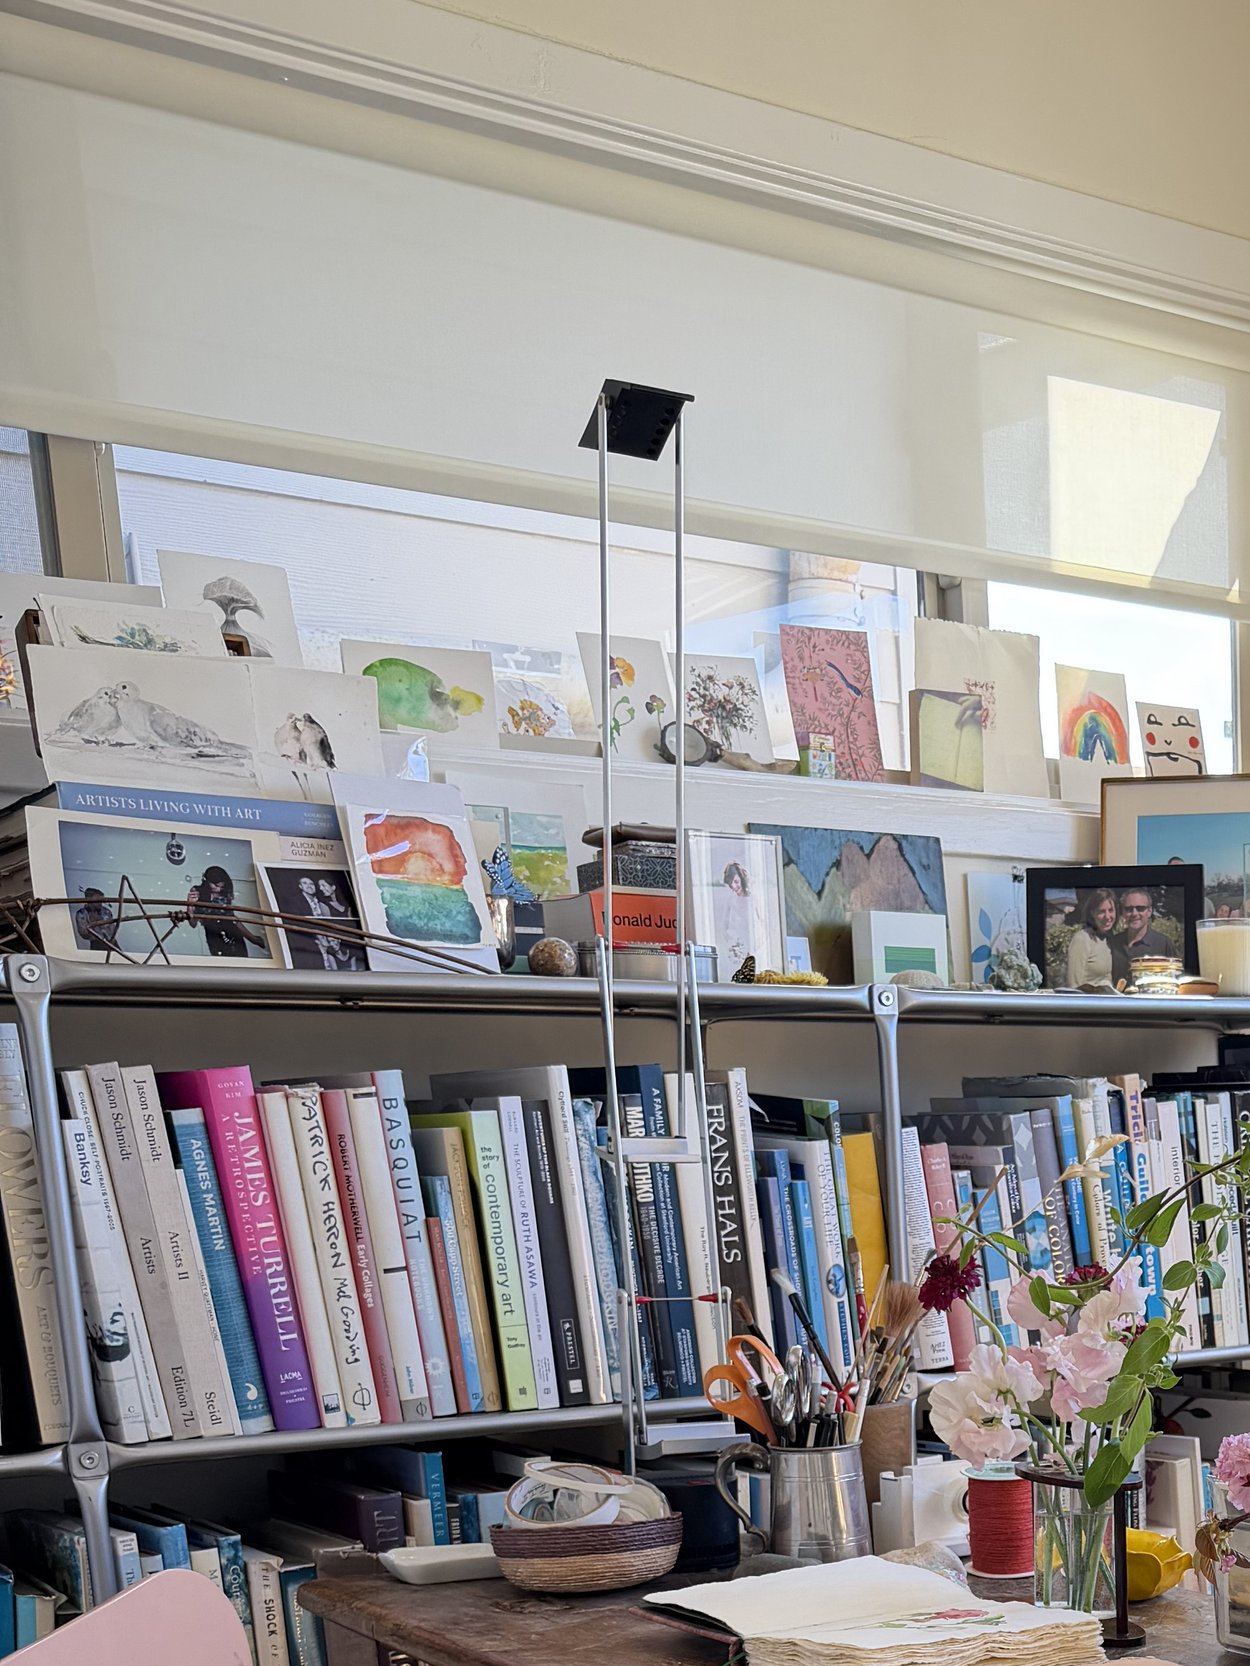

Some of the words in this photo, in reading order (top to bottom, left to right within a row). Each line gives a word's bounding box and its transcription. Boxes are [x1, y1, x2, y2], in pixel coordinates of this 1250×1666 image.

[76, 794, 136, 809] ARTISTS
[140, 799, 190, 813] LIVING
[193, 804, 231, 818] WITH
[235, 808, 262, 820] ART
[290, 841, 315, 850] ALICIA
[317, 842, 334, 850] INEZ
[602, 911, 651, 928] onald
[226, 1091, 242, 1099] KIM
[557, 1091, 568, 1117] Clyfford
[651, 1087, 659, 1095] A
[734, 1080, 744, 1107] AXSOM
[651, 1097, 664, 1135] FAMILY
[338, 1134, 350, 1171] ROBERT
[511, 1143, 520, 1157] THE
[706, 1104, 733, 1187] FRANS
[738, 1129, 748, 1152] PRINTS
[74, 1132, 92, 1186] Banksy
[382, 1097, 422, 1243] BASQUIAT
[742, 1154, 749, 1162] OF
[817, 1163, 826, 1178] OF
[821, 1150, 832, 1173] THE
[1167, 1145, 1185, 1185] interior
[512, 1158, 525, 1193] SCULPTURE
[655, 1171, 667, 1200] Collection
[661, 1173, 672, 1197] Modern
[743, 1164, 755, 1201] ELLSWORTH
[191, 1139, 211, 1190] AGNES
[203, 1194, 226, 1251] MARTIN
[222, 1114, 230, 1122] A
[226, 1132, 262, 1275] RETROSPECTIVE
[344, 1175, 365, 1242] MOTHERWELL
[519, 1197, 526, 1209] OF
[782, 1186, 790, 1201] THE
[818, 1183, 831, 1216] YOUR
[824, 1178, 839, 1217] GREAT
[1043, 1196, 1056, 1218] OF
[1070, 1184, 1078, 1203] Century
[1091, 1184, 1103, 1216] Colors
[1098, 1223, 1103, 1231] of
[519, 1211, 532, 1242] RUTH
[647, 1205, 656, 1218] THE
[660, 1209, 671, 1234] Stanford
[749, 1202, 757, 1220] KELLY
[1101, 1189, 1119, 1242] White
[234, 1111, 270, 1207] JAMES
[256, 1214, 299, 1351] TURRELL
[301, 1093, 331, 1191] PATRICK
[322, 1201, 346, 1269] HERON
[341, 1306, 361, 1365] Gooding
[648, 1220, 662, 1253] DECISIVE
[664, 1210, 680, 1251] Contemporary
[700, 1239, 708, 1250] Roy
[716, 1195, 742, 1264] HALS
[785, 1204, 797, 1257] CROSSROADS
[823, 1221, 835, 1247] LIFE
[828, 1223, 843, 1258] WORK
[102, 1077, 118, 1109] Jason
[112, 1111, 132, 1161] Schmidt
[140, 1237, 156, 1275] Artists
[171, 1366, 188, 1408] Edition
[182, 1411, 195, 1427] 7L
[134, 1079, 149, 1110] Jason
[143, 1113, 162, 1162] Schmidt
[168, 1231, 183, 1268] Artists
[178, 1272, 189, 1281] II
[204, 1391, 222, 1426] Steidl
[357, 1244, 368, 1271] Early
[485, 1174, 509, 1288] contemporary
[501, 1291, 515, 1316] art
[663, 1235, 676, 1263] University
[1048, 1224, 1066, 1283] COLOR
[523, 1245, 538, 1288] ASAWA
[652, 1255, 665, 1283] DECADE
[671, 1251, 683, 1279] American
[791, 1259, 798, 1269] OF
[361, 1270, 375, 1308] Collages
[409, 1258, 425, 1310] NOTEBOOKS
[453, 1264, 463, 1296] Street
[676, 1279, 684, 1290] Art
[36, 1305, 49, 1329] ART
[565, 1332, 575, 1364] PRESTEL
[837, 1302, 847, 1339] STEPHEN
[842, 1343, 850, 1364] COPE
[931, 1356, 949, 1364] TERRA
[280, 1371, 303, 1384] LACMA
[431, 1474, 444, 1537] VERMEER
[260, 1566, 271, 1589] THE
[263, 1597, 279, 1636] SHOCK
[269, 1644, 278, 1658] OF
